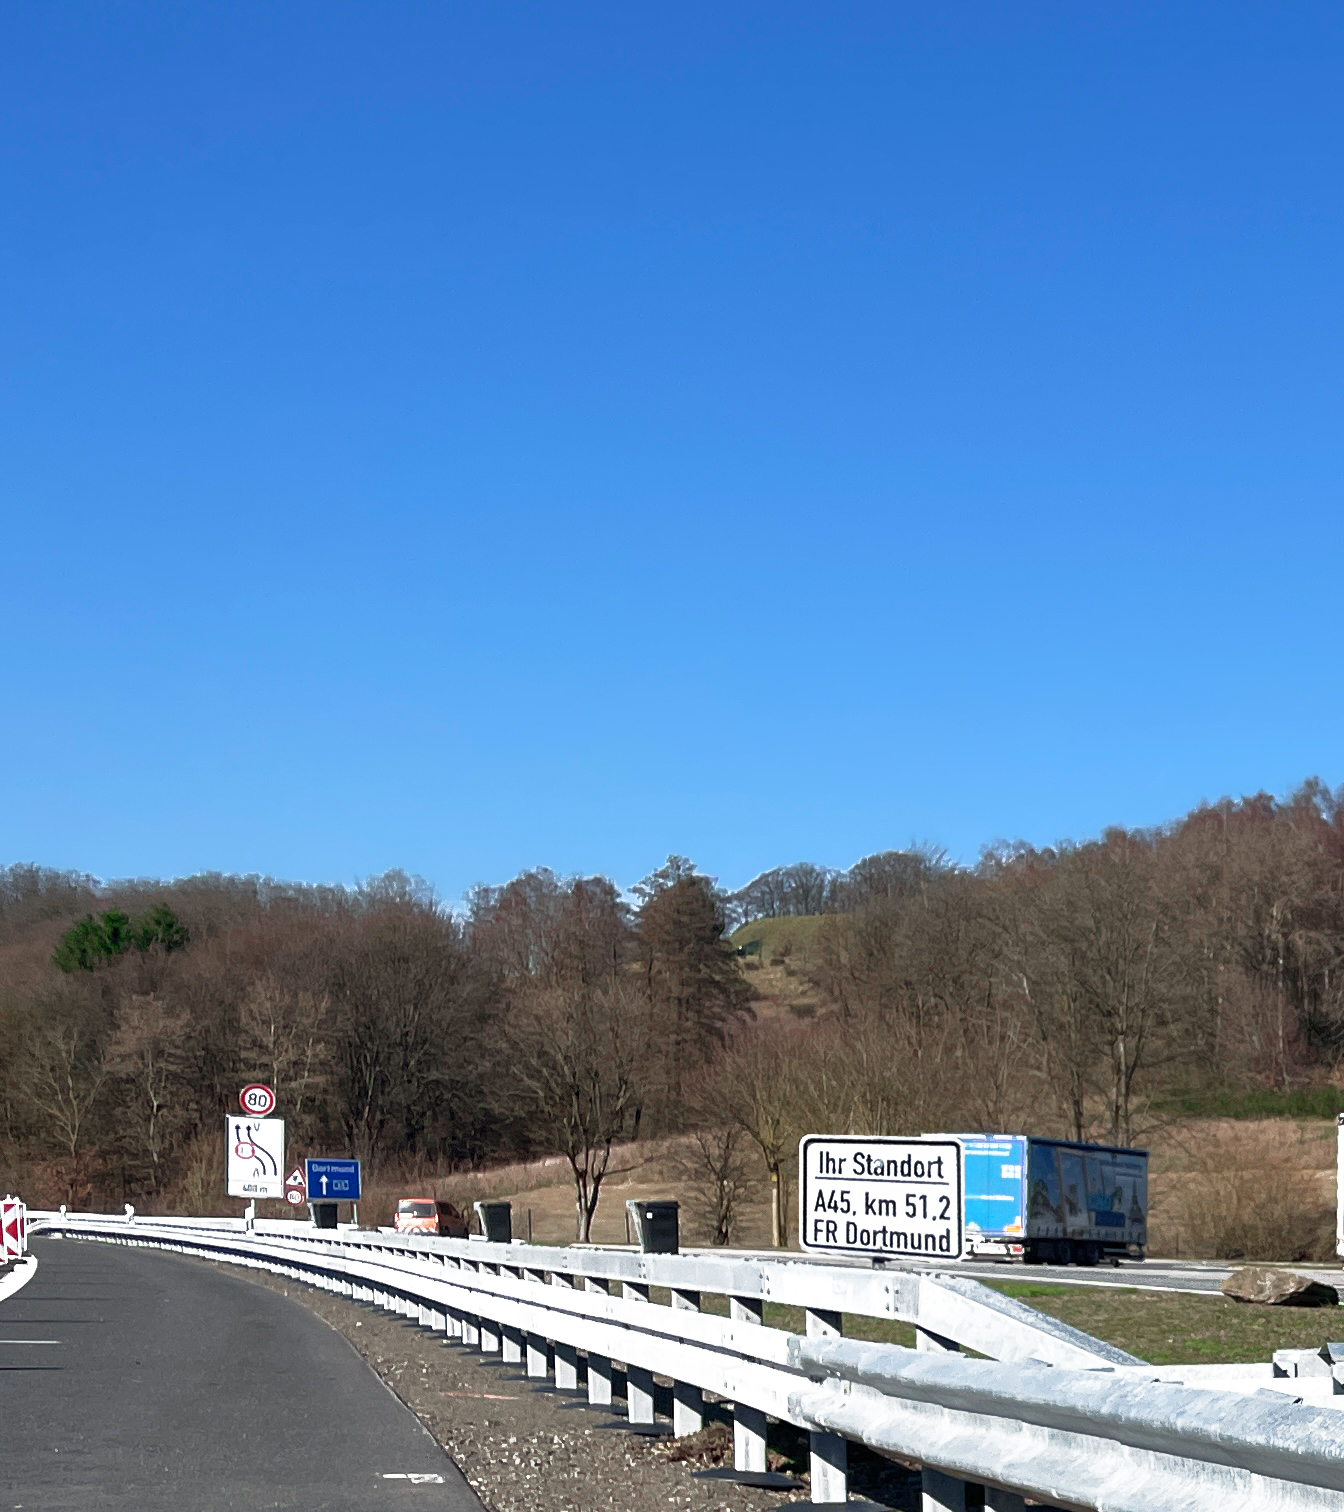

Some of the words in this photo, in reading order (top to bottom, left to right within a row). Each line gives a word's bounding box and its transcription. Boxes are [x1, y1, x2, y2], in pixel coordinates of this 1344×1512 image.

[248, 1093, 267, 1107] 80
[819, 1151, 846, 1174] Ihr
[852, 1152, 944, 1179] Standort
[865, 1191, 897, 1217] km
[814, 1219, 838, 1243] FR
[846, 1221, 951, 1252] Dortmund
